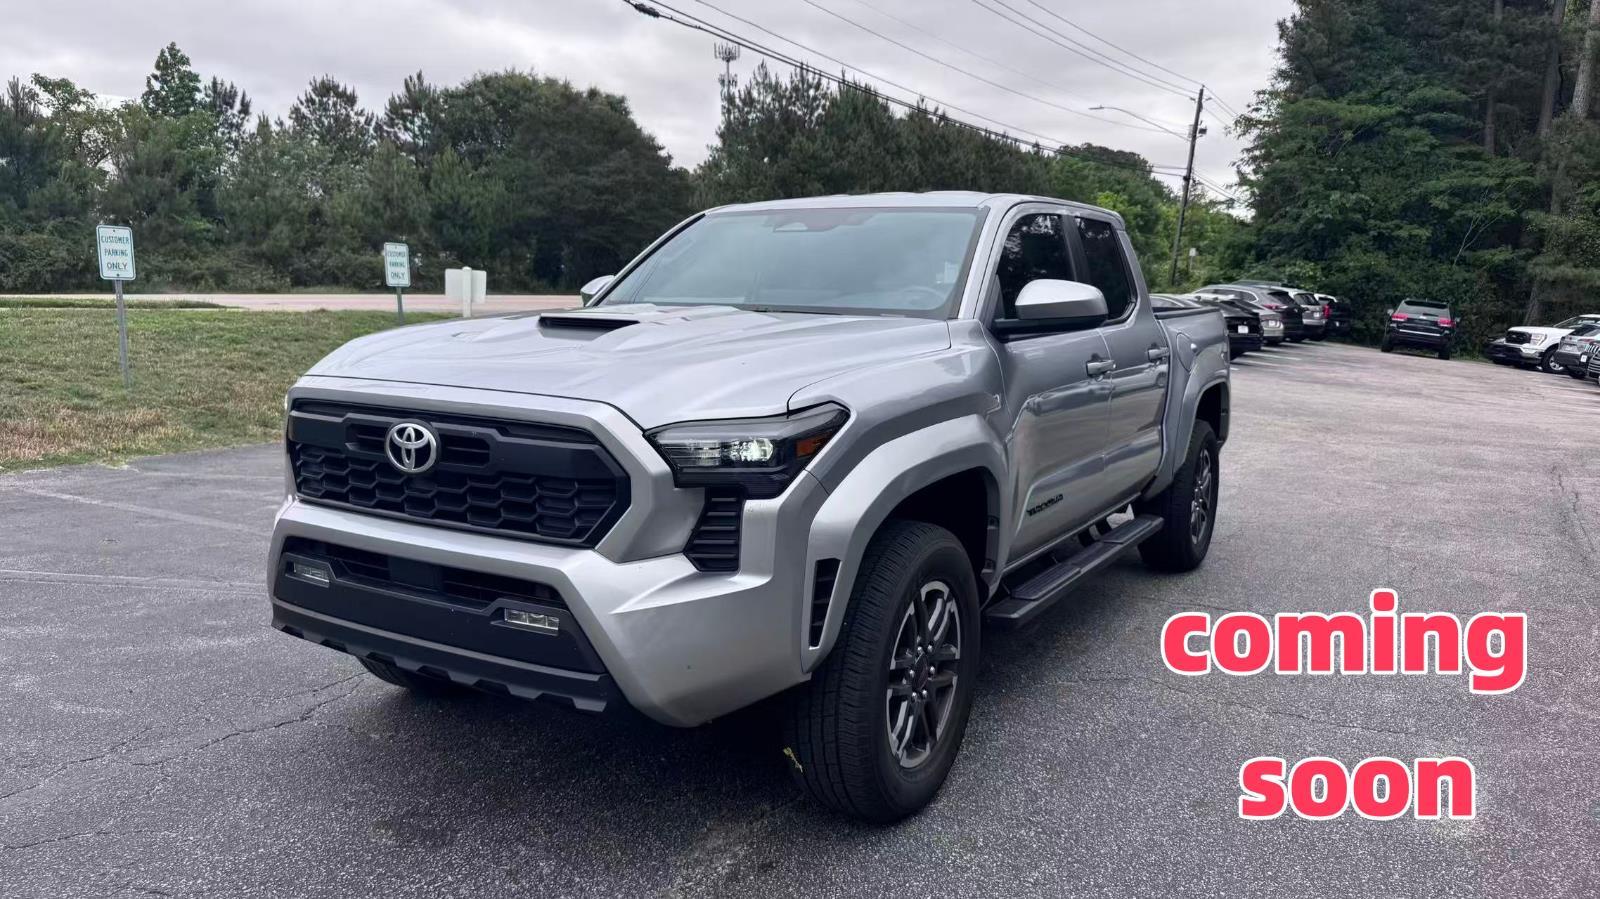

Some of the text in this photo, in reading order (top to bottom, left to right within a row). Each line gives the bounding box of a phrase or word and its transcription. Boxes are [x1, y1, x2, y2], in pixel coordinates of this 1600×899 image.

[101, 236, 130, 244] CUSTOMER
[104, 248, 129, 256] PARKING
[107, 261, 128, 270] ONLY
[391, 272, 405, 280] ONLY
